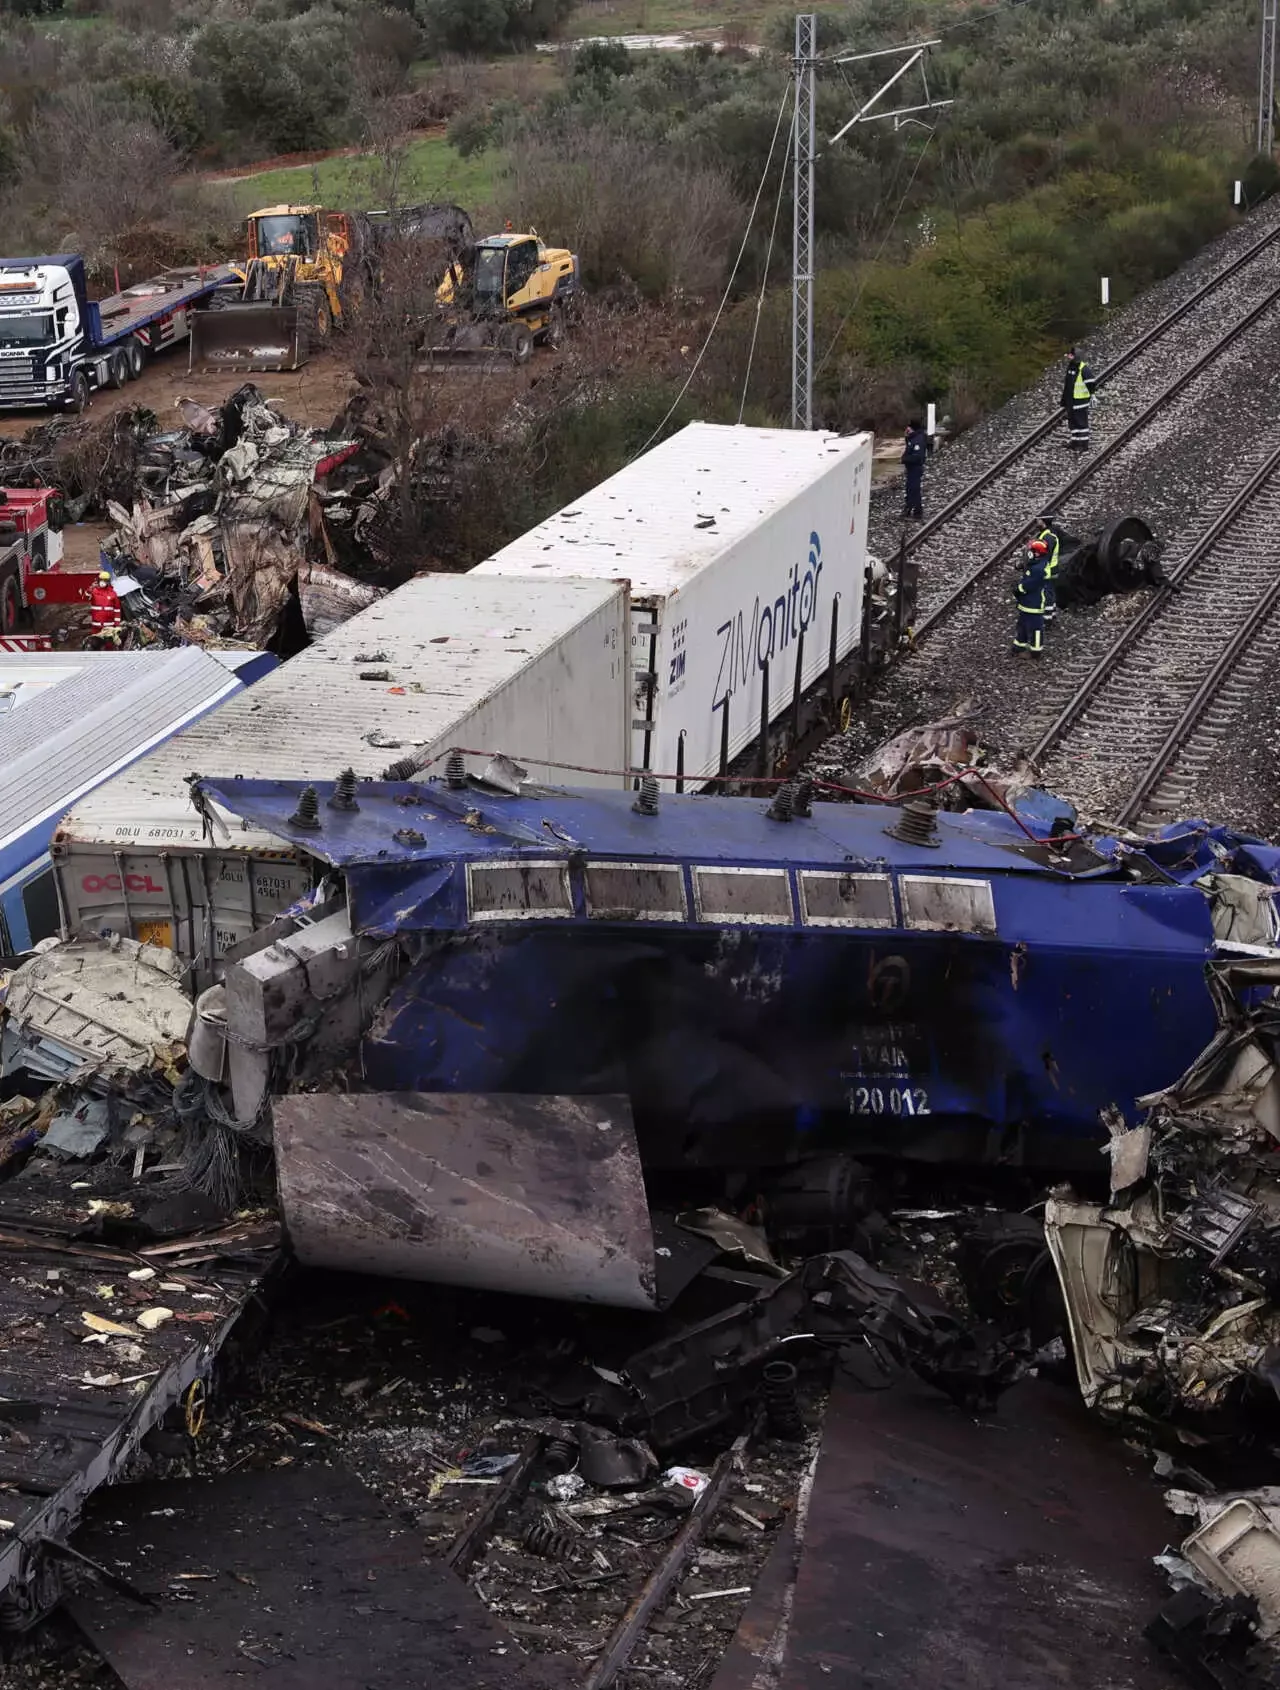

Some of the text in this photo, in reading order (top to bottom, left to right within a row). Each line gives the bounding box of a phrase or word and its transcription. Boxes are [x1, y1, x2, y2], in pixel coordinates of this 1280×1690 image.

[669, 650, 687, 686] ZIM
[148, 829, 184, 838] 687031
[82, 874, 164, 893] OOCL
[256, 876, 291, 888] 687031
[257, 886, 280, 899] 45G1
[216, 930, 237, 942] MGW
[845, 1087, 932, 1116] 120 012
